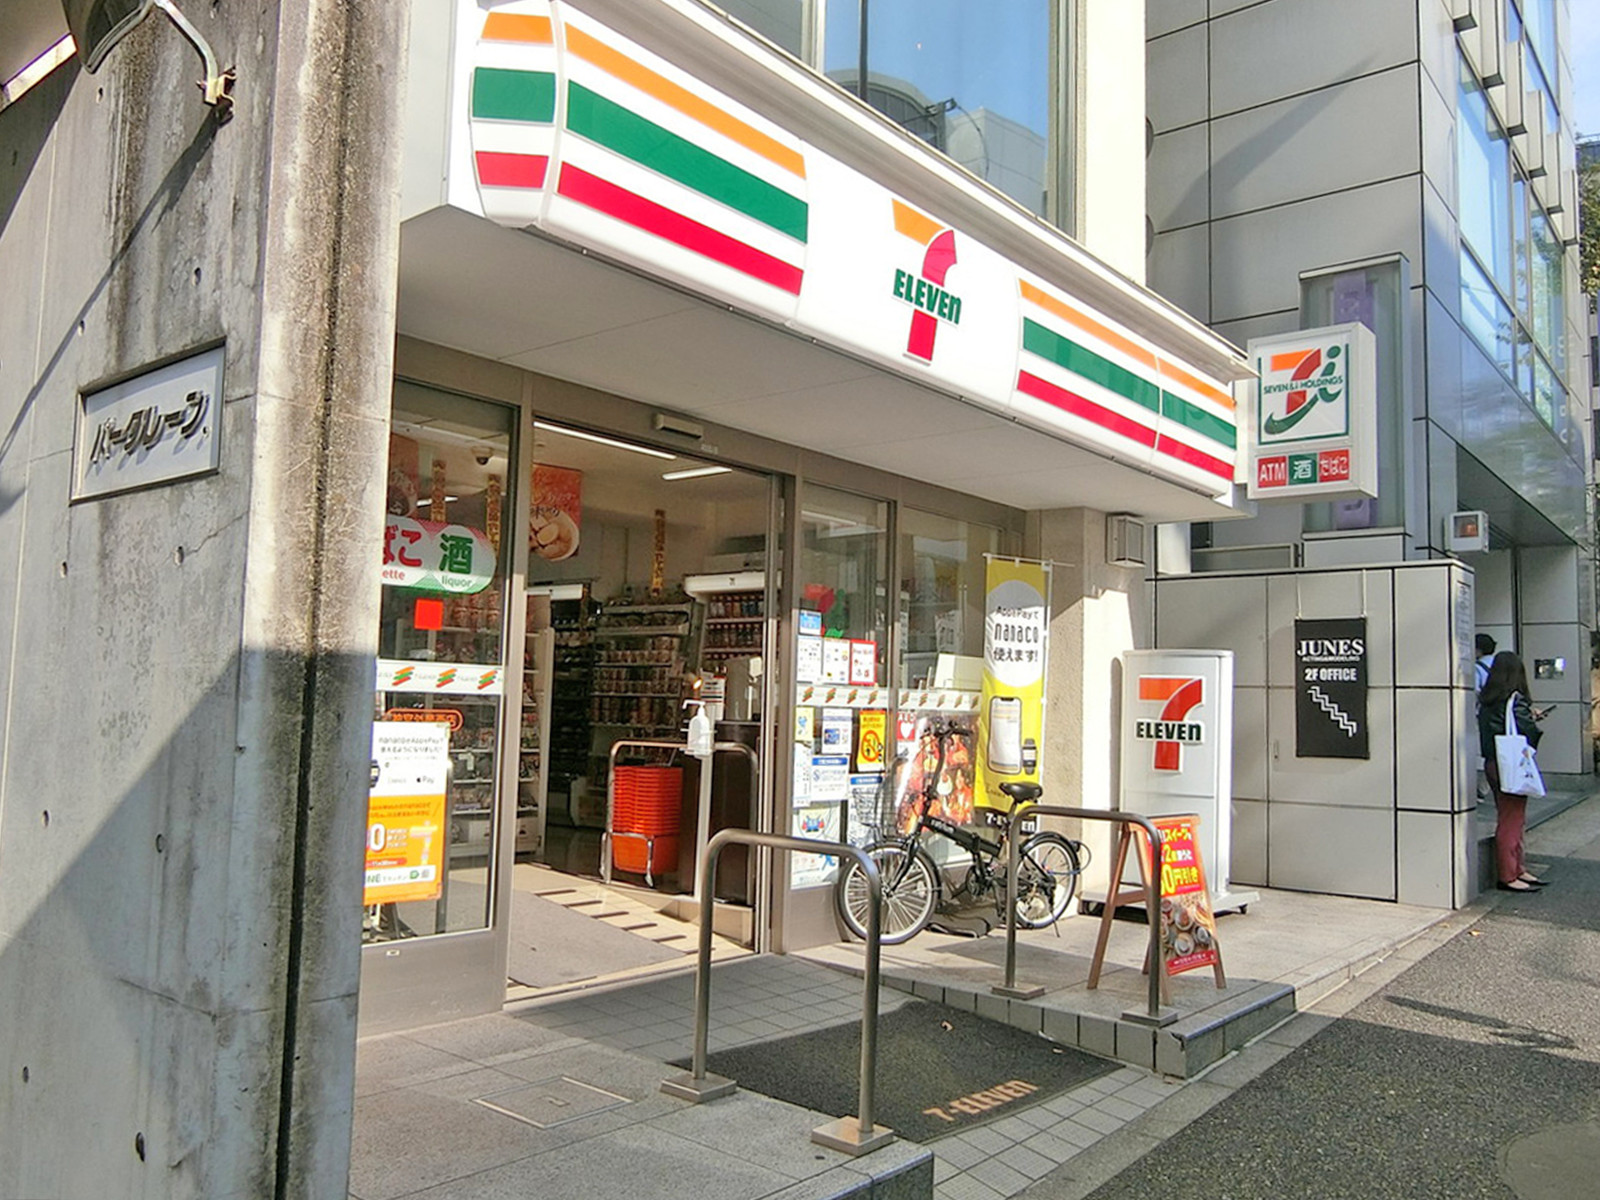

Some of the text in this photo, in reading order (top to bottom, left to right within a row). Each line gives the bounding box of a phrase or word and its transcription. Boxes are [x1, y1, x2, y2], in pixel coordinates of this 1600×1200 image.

[1300, 375, 1343, 389] HOLDINGS
[1259, 462, 1286, 481] ATM
[1293, 456, 1348, 479] 酒 たばこ
[439, 533, 474, 574] 酒
[441, 575, 473, 588] liquor
[994, 623, 1039, 643] nanaco
[1296, 639, 1365, 656] JUNES
[1304, 667, 1358, 681] 2F OFFICE
